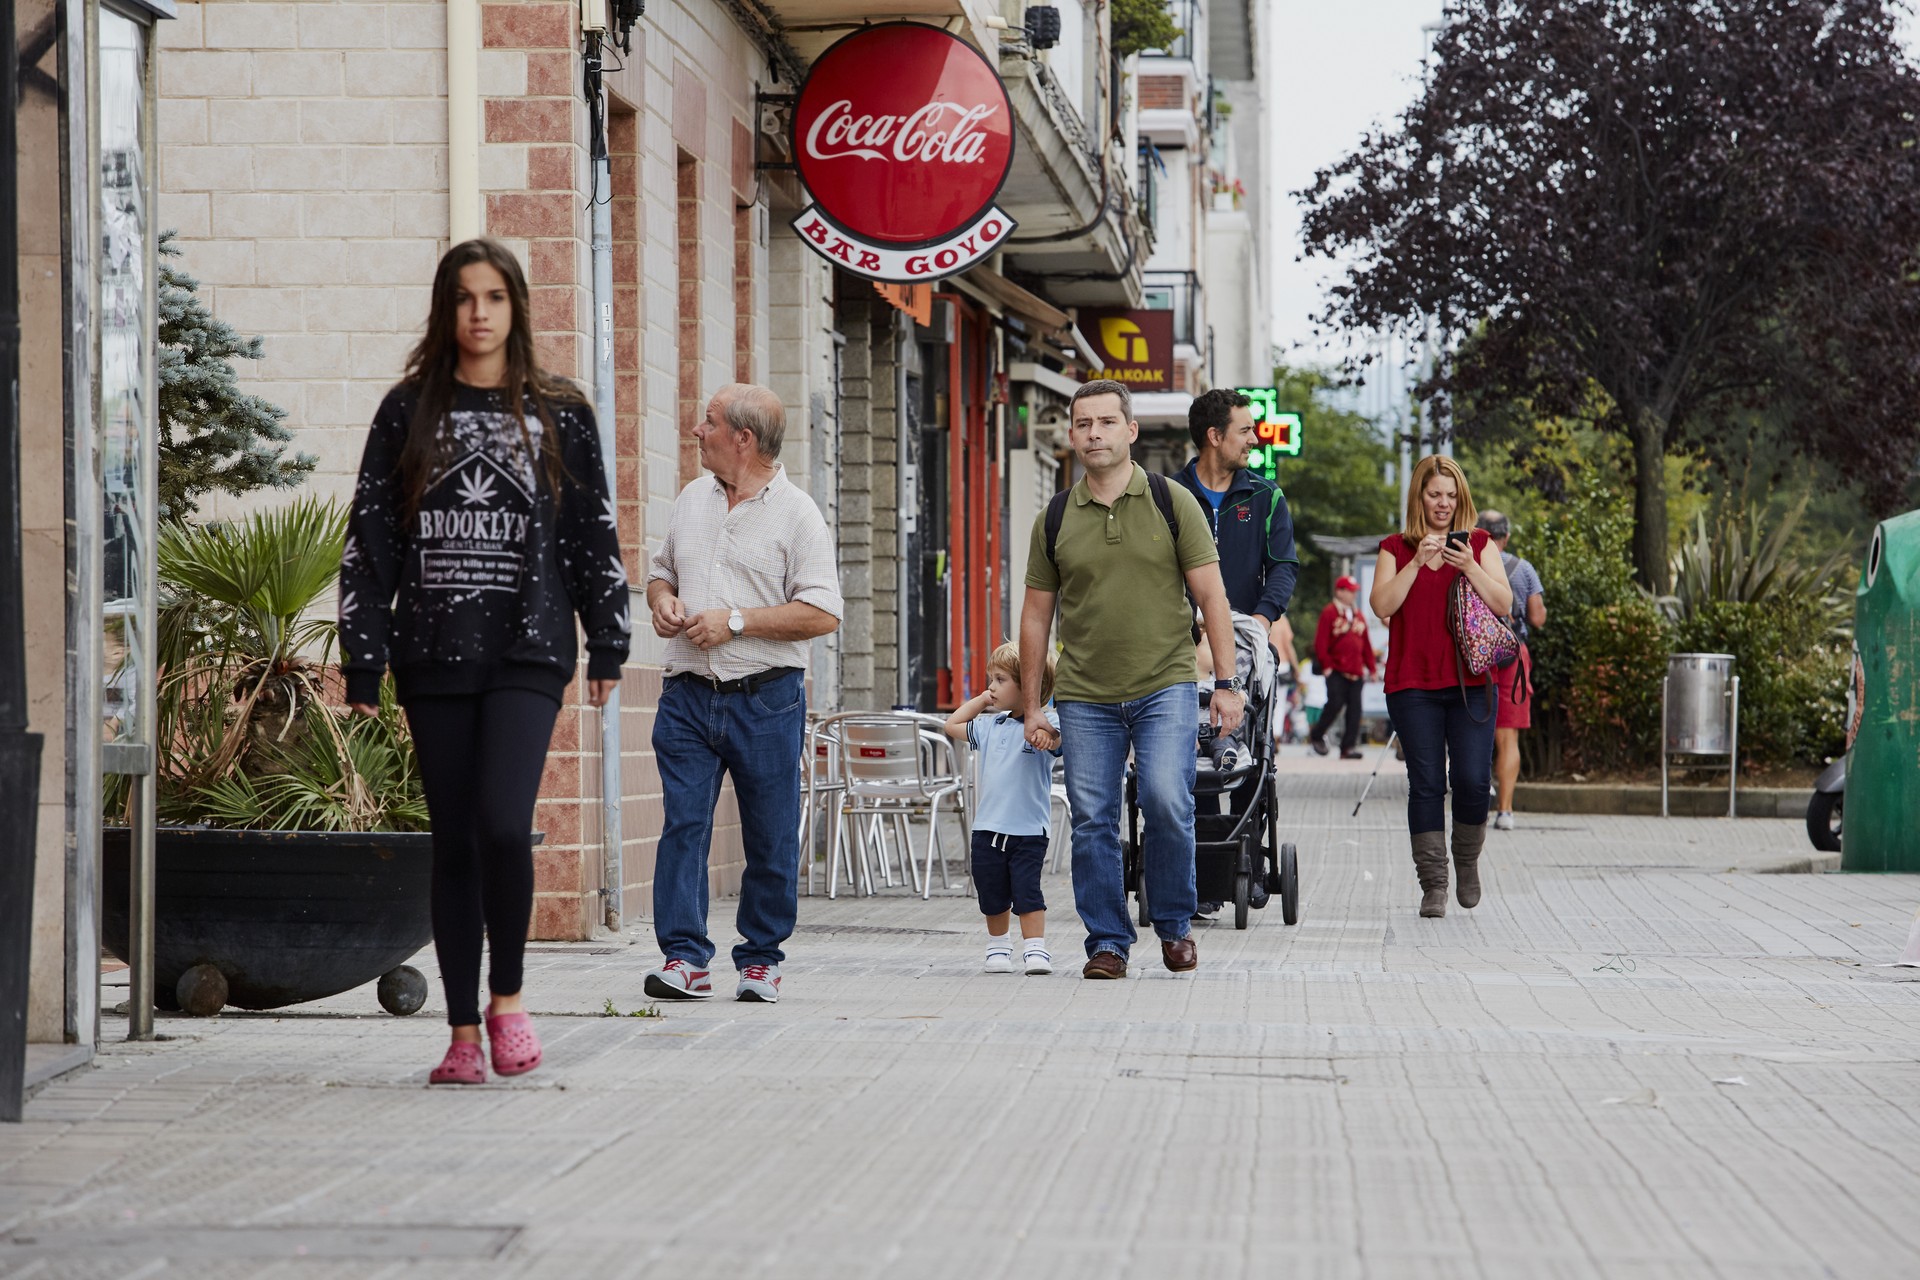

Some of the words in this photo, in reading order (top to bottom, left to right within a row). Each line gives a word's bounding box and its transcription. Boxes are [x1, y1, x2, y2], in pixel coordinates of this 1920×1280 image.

[806, 99, 999, 163] Coca-Cola
[802, 218, 881, 272] BAR
[905, 219, 1003, 275] GOYO
[419, 510, 530, 543] BROOKLYN
